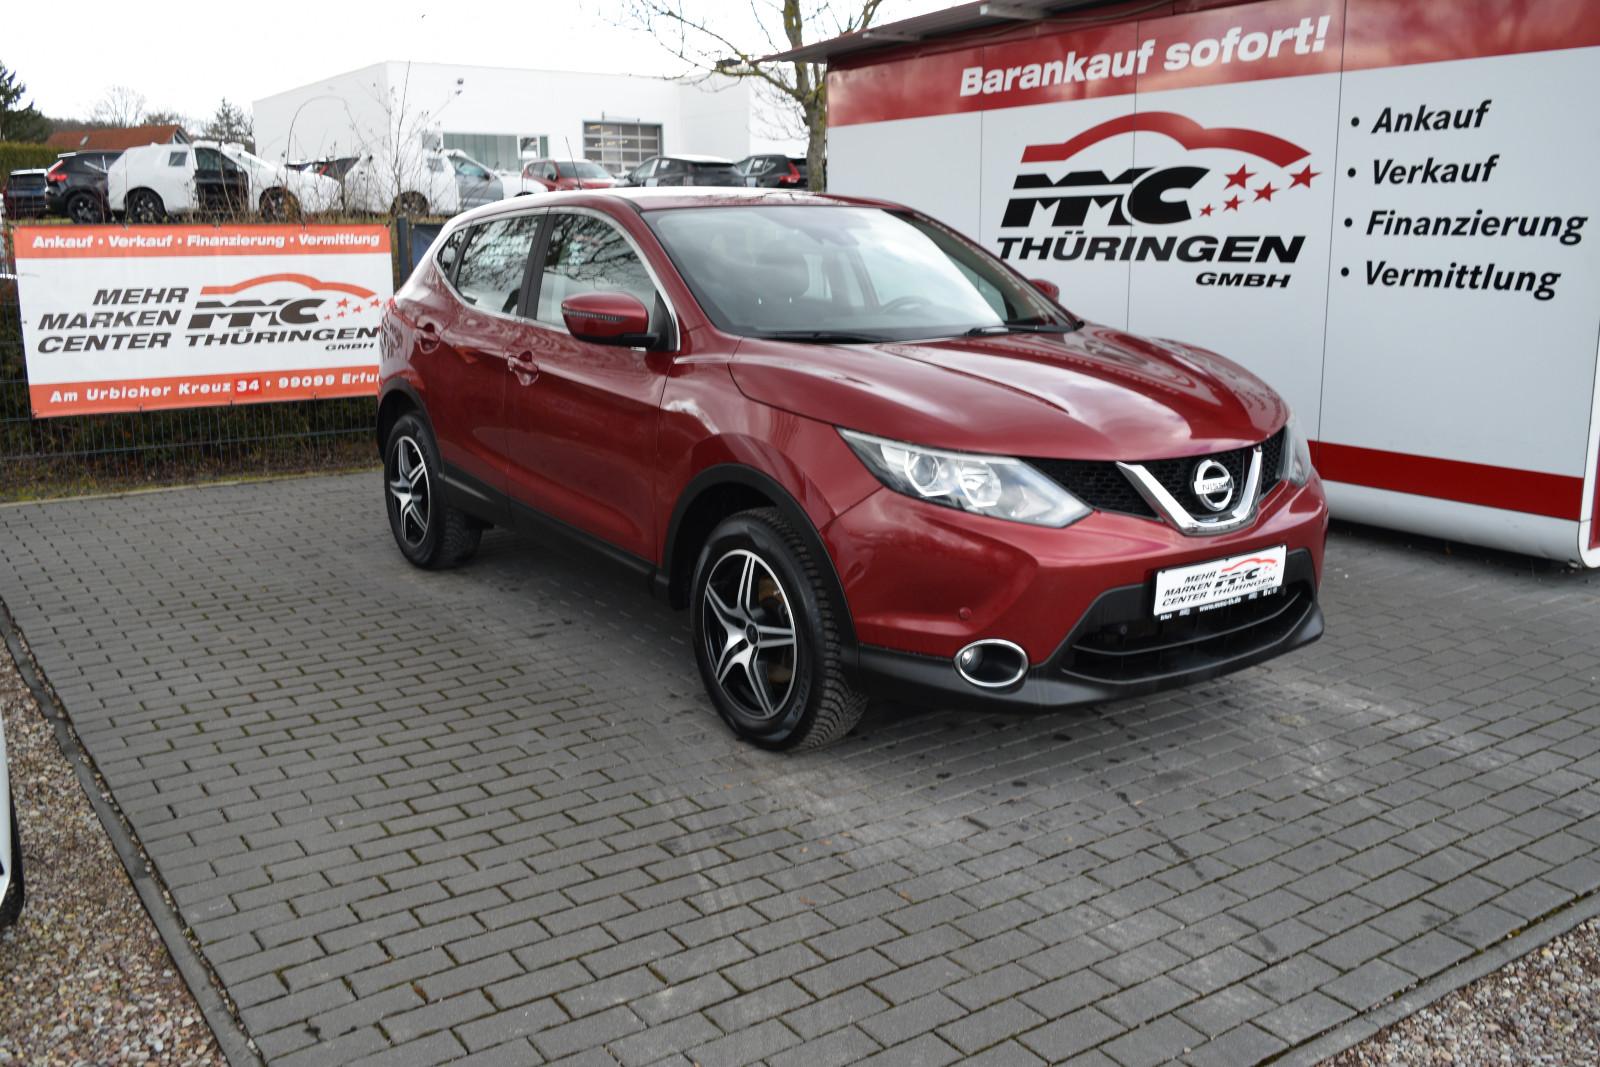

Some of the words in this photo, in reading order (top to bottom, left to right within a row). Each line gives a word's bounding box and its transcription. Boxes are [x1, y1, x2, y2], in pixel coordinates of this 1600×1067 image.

[959, 39, 1156, 97] Barankauf
[1163, 15, 1331, 72] sofort!
[1371, 99, 1493, 134] Ankauf
[1373, 154, 1500, 185] Verkauf
[1366, 209, 1588, 246] Finanzierung
[32, 235, 94, 249] Ankauf
[109, 234, 173, 248] Verkauf
[187, 234, 285, 248] Finanzierung
[298, 233, 380, 247] Vermittlung
[997, 230, 1306, 264] THÜRINGEN
[1195, 272, 1291, 288] GMBH
[1365, 260, 1561, 301] Vermittlung
[92, 287, 189, 306] MEHR
[37, 310, 182, 331] MARKEN
[37, 332, 172, 354] CENTER
[185, 327, 379, 348] THÜRINGEN
[325, 343, 375, 352] GMBH
[50, 390, 78, 403] Am
[86, 384, 171, 401] Urbicher
[178, 382, 232, 396] Kreuz
[236, 379, 260, 393] 34
[278, 375, 335, 389] 99099
[1184, 571, 1217, 584] MEHR
[1162, 592, 1207, 606] CENTER
[1213, 576, 1275, 597] THÜRINGEN
[1164, 581, 1212, 597] MARKEN
